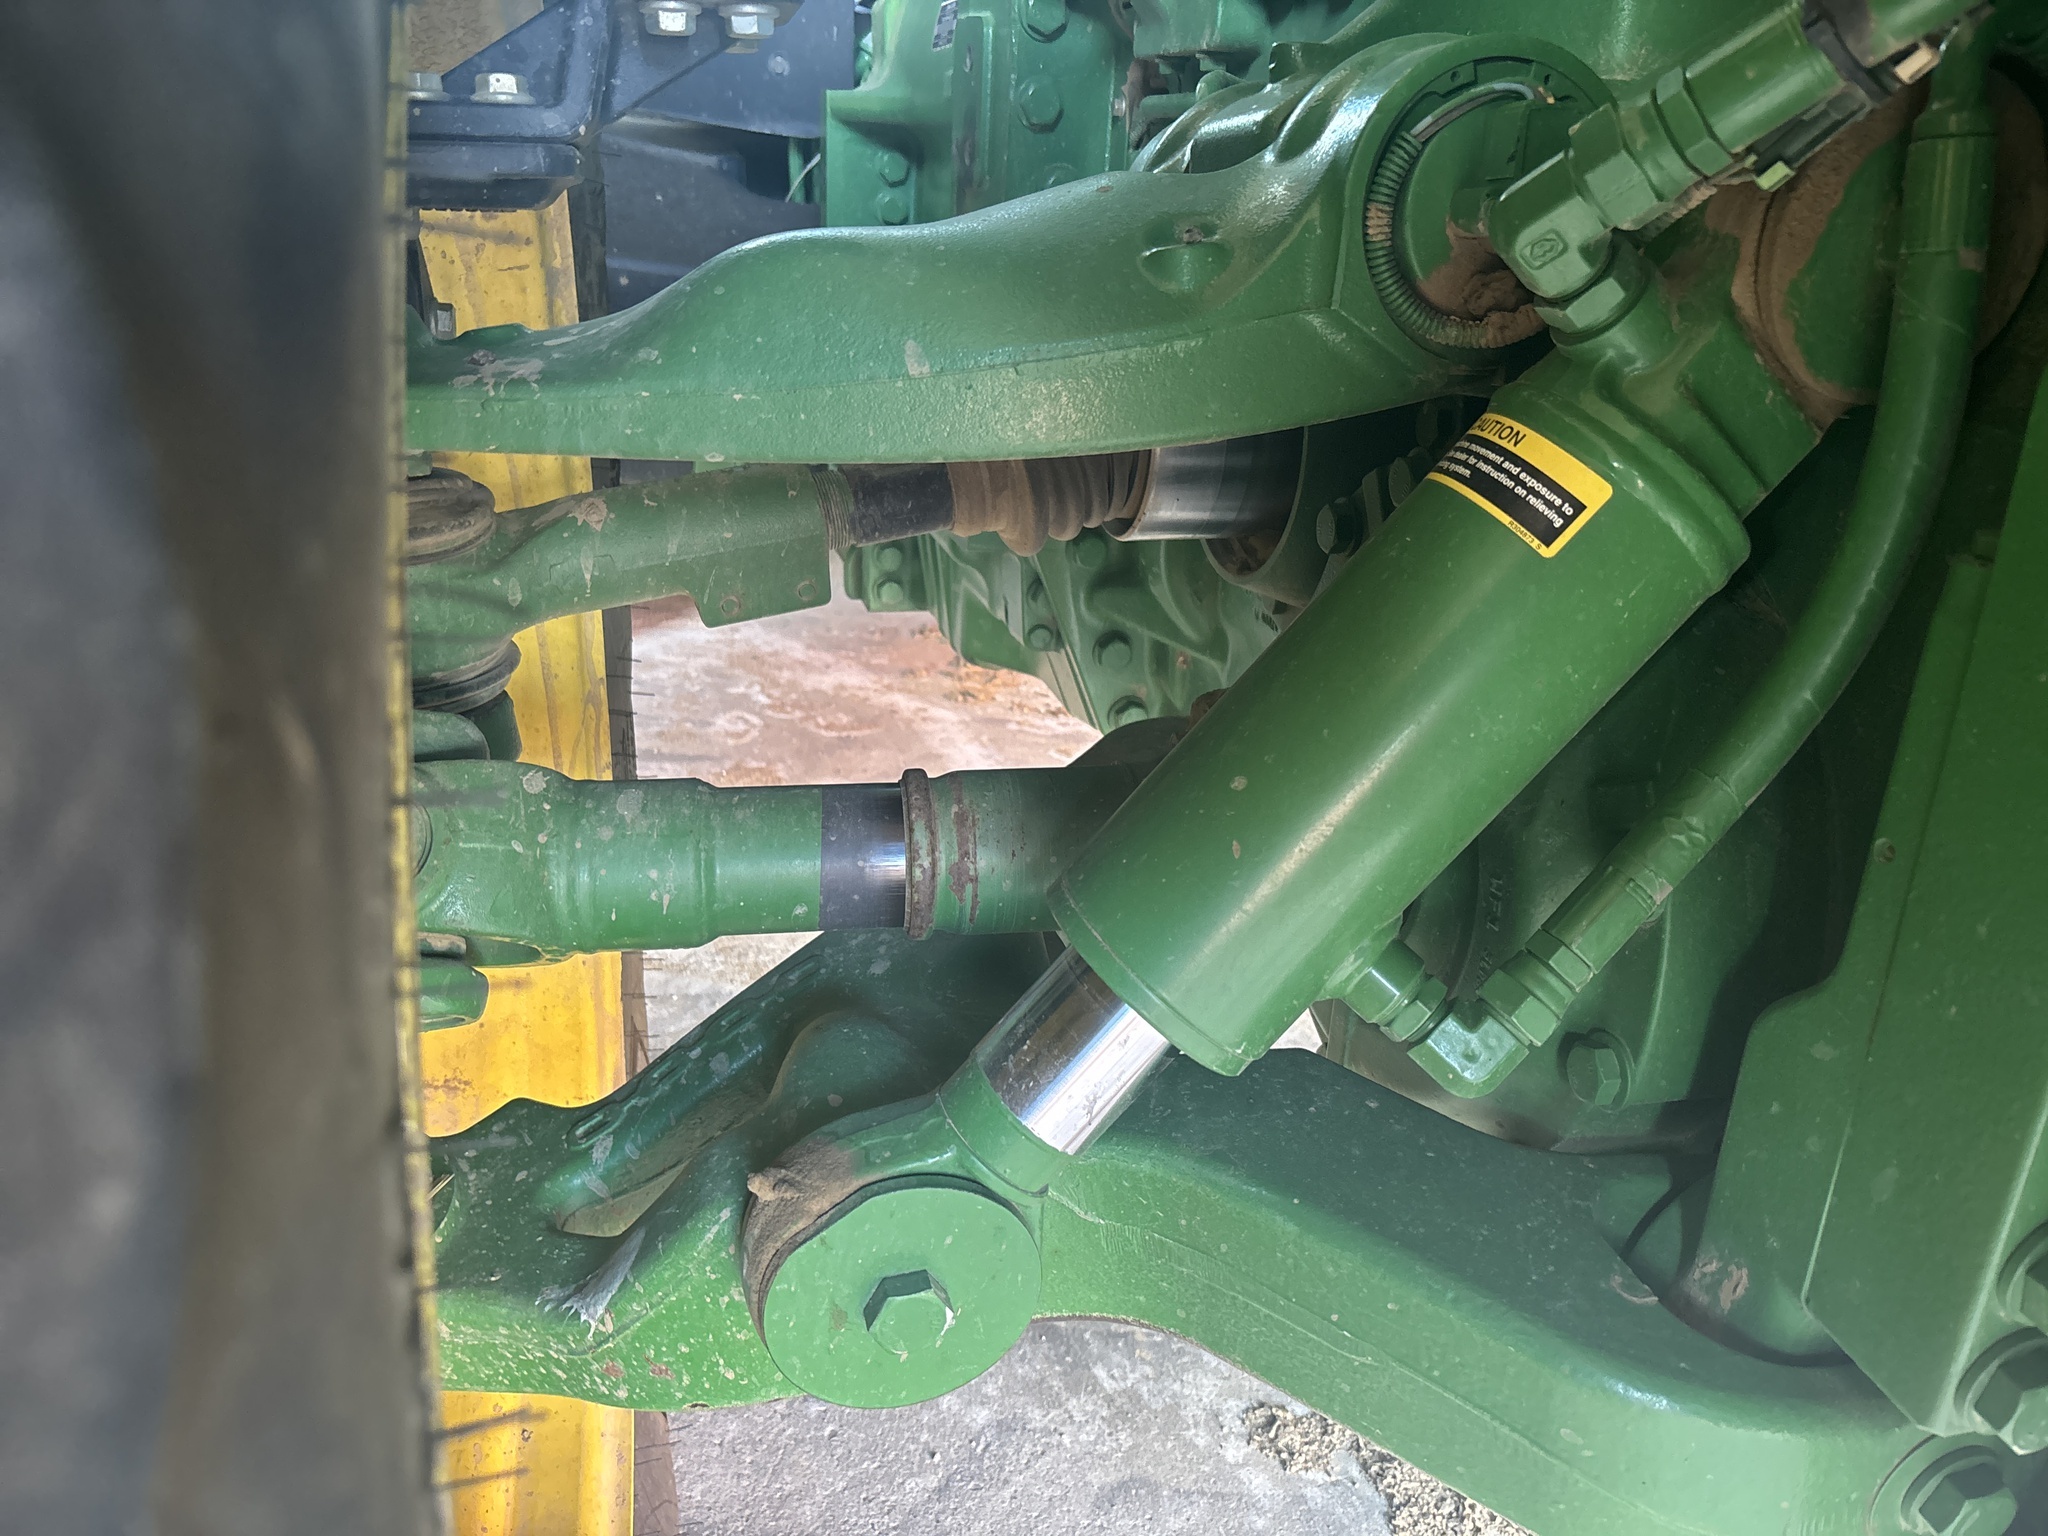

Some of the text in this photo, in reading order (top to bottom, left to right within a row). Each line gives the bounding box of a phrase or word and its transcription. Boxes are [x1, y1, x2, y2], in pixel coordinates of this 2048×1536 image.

[1449, 463, 1472, 478] system.
[1468, 443, 1505, 465] movement
[1502, 460, 1522, 476] and
[1519, 472, 1563, 507] exposure
[1561, 502, 1574, 516] to
[1475, 459, 1515, 489] instruction
[1514, 485, 1527, 498] on
[1526, 494, 1564, 528] relieving
